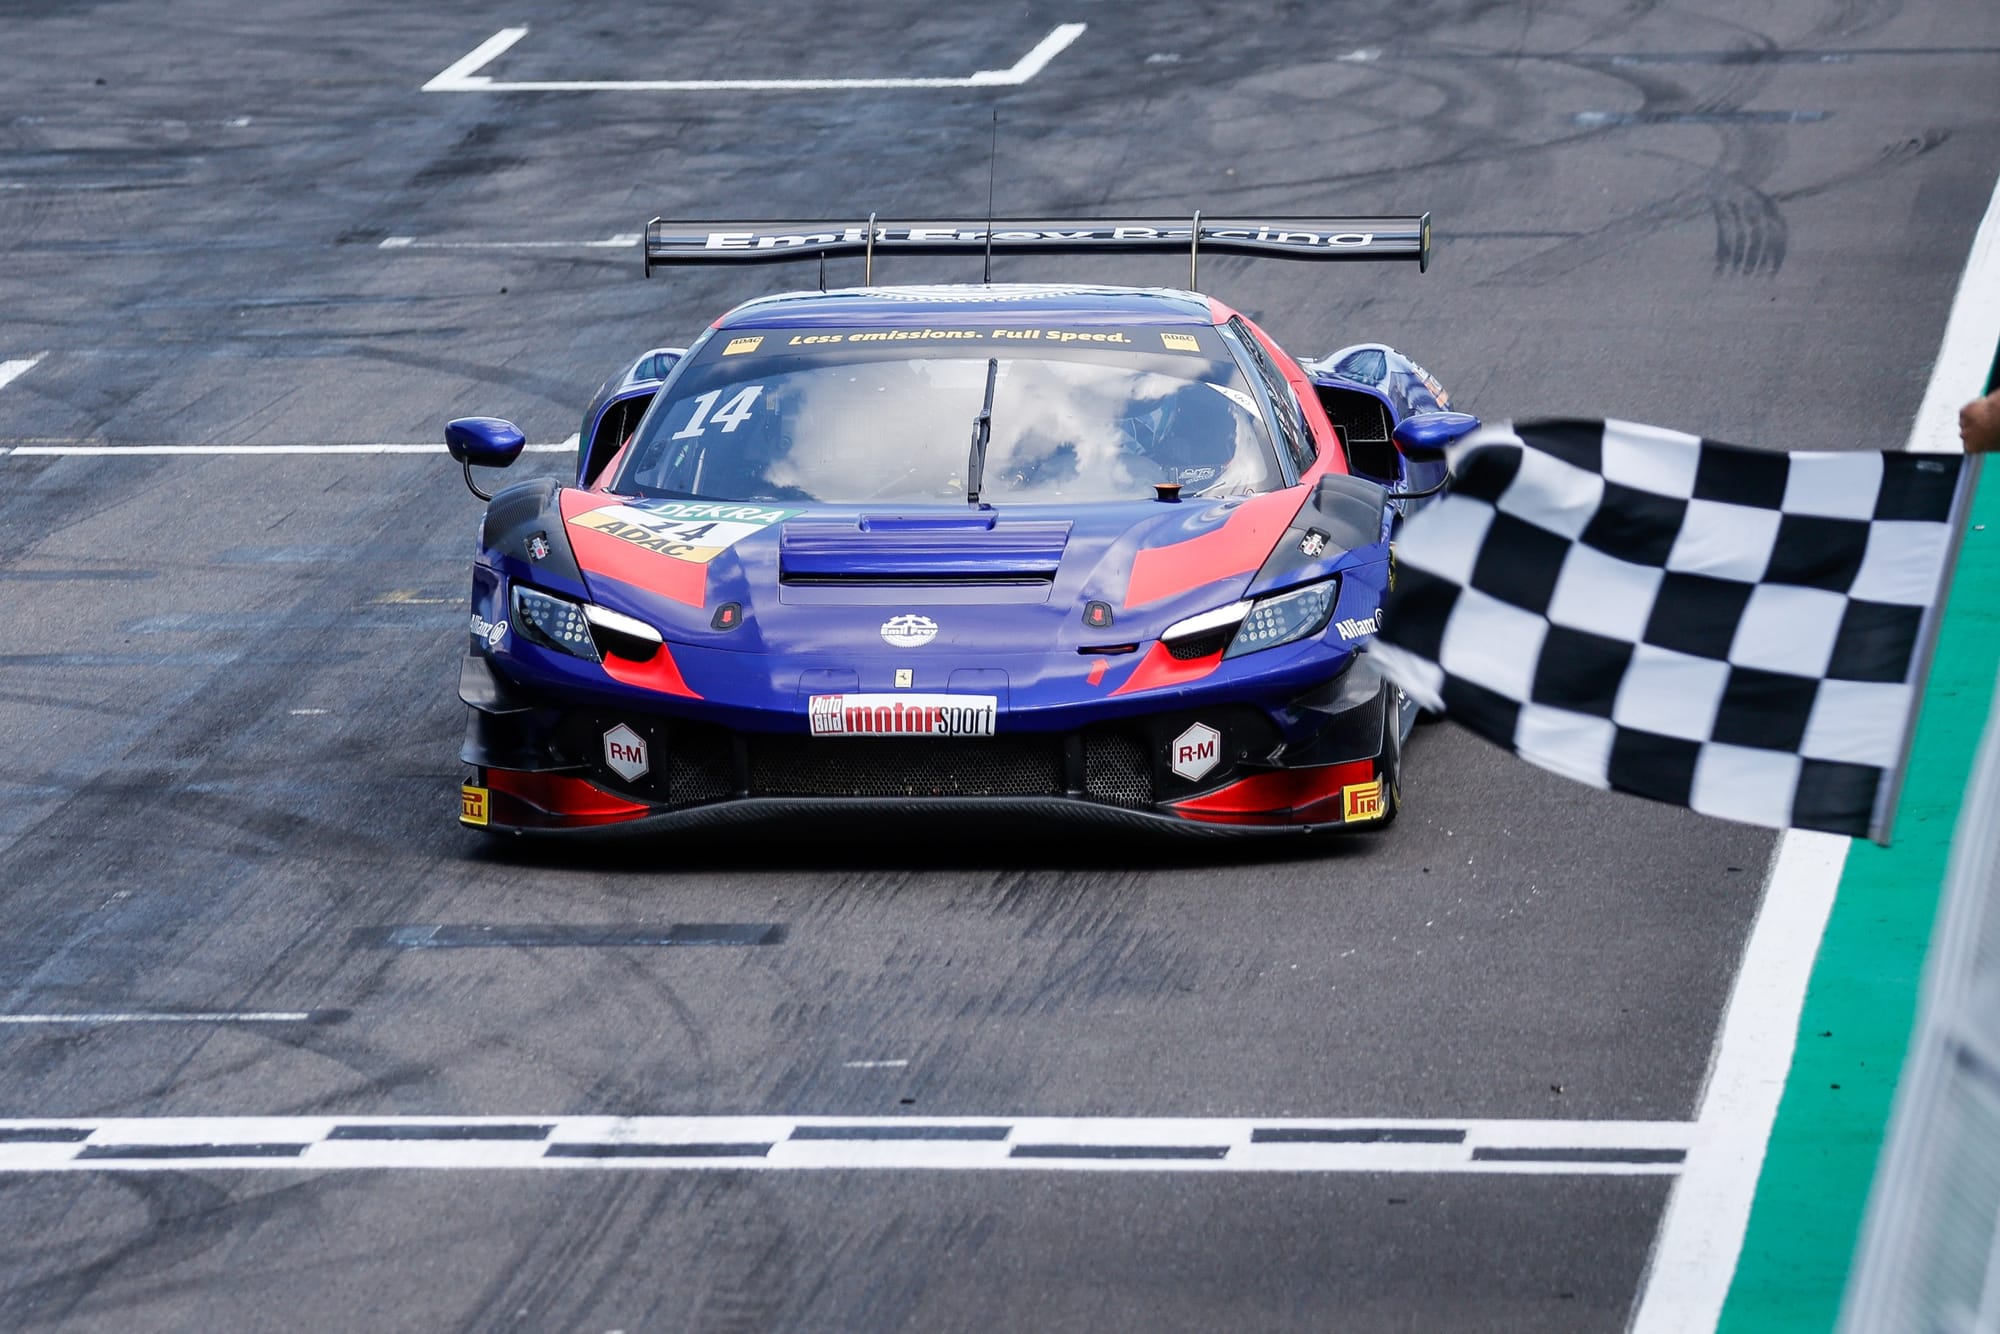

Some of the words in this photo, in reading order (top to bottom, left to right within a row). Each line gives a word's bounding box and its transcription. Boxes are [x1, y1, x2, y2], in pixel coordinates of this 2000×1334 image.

[704, 227, 887, 250] Emil
[1112, 226, 1374, 248] Racing
[788, 334, 843, 346] Less
[847, 328, 983, 343] emissions.
[991, 329, 1041, 340] Full
[1045, 330, 1132, 344] Speed.
[671, 385, 764, 440] 14
[650, 502, 785, 523] DEKRA
[592, 520, 696, 557] ADAC
[640, 520, 720, 542] 14
[1334, 616, 1379, 641] Allianz
[811, 696, 843, 714] Auto
[813, 713, 843, 732] Bild
[609, 741, 643, 764] R-M
[1178, 740, 1215, 763] R-M
